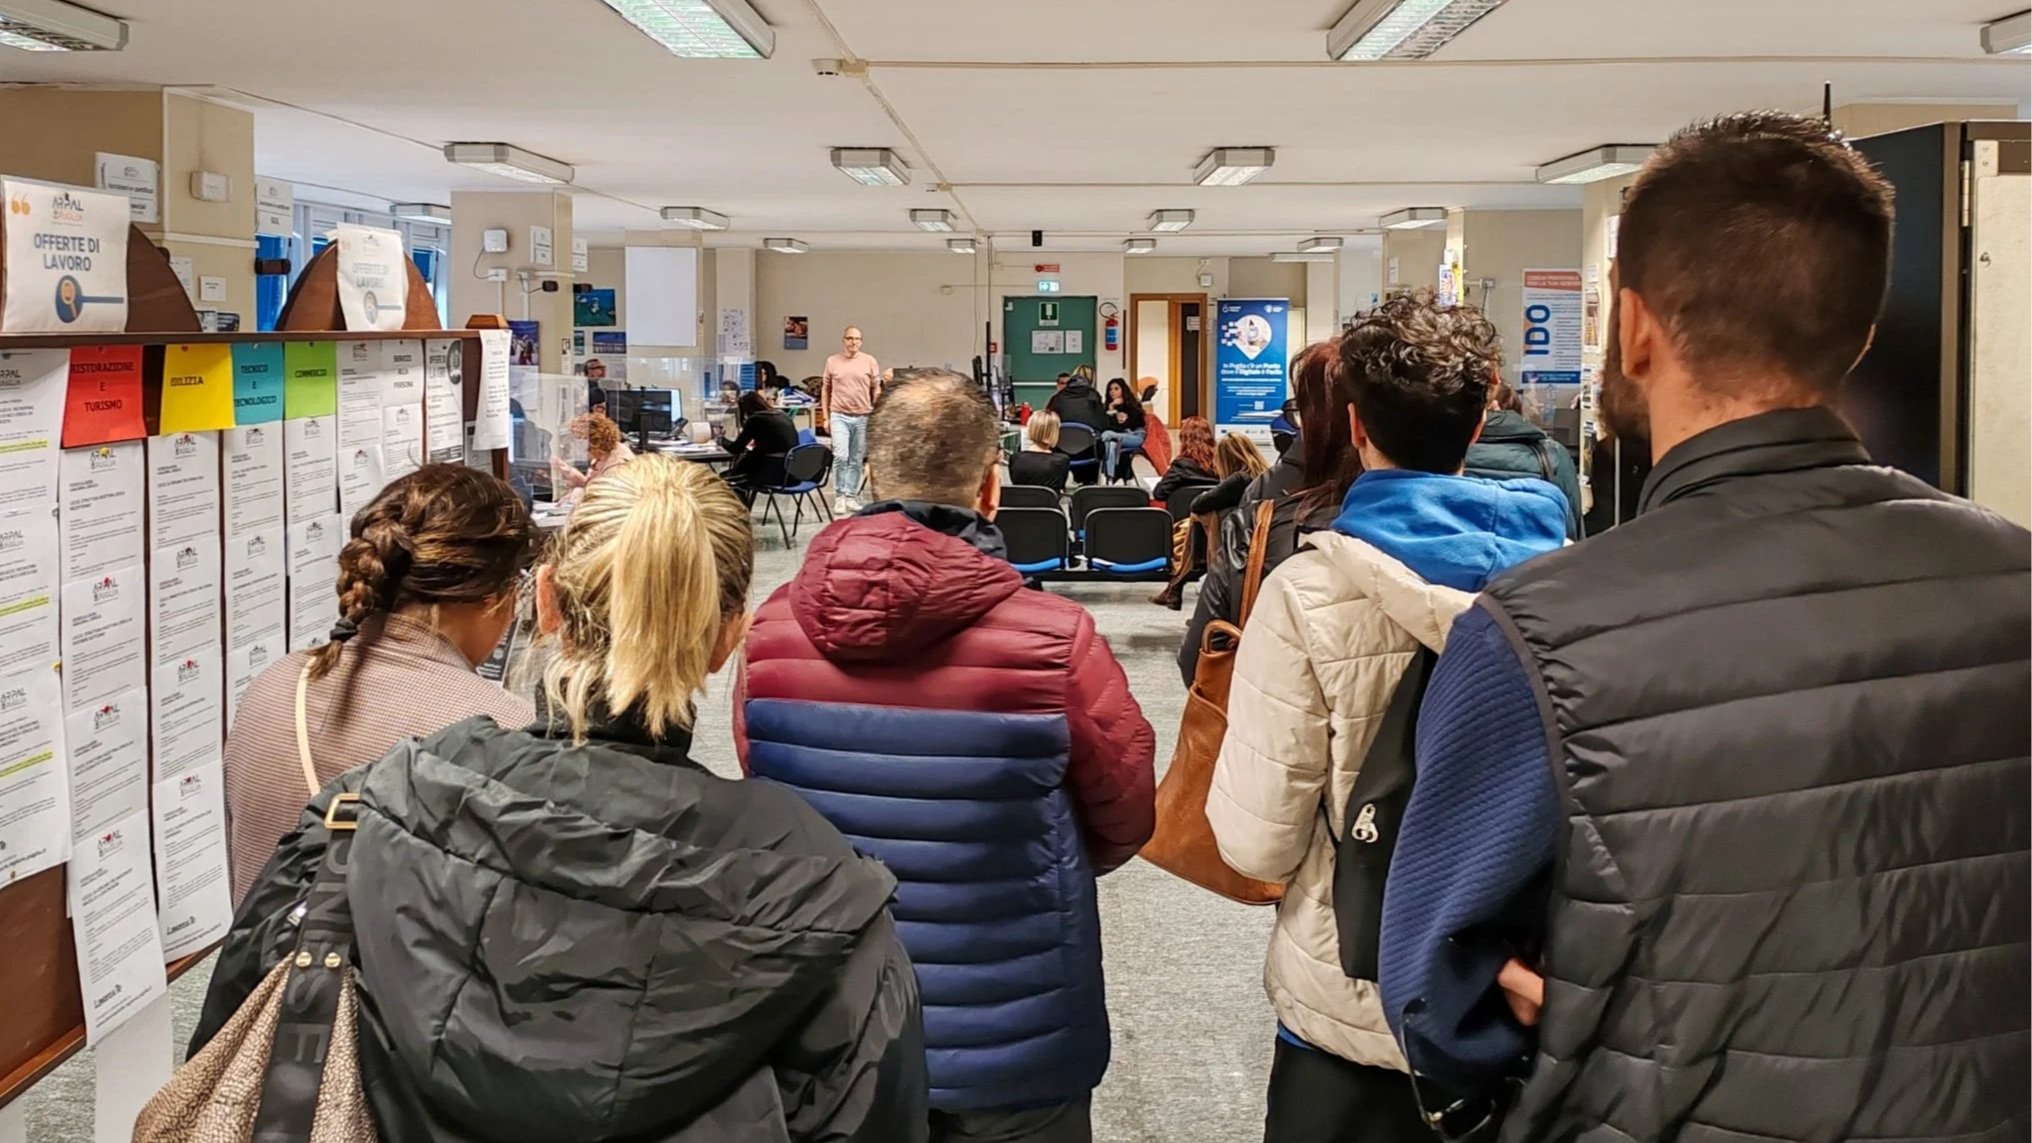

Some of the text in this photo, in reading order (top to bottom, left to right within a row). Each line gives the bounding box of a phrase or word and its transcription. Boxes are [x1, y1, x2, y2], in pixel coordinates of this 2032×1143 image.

[34, 233, 100, 253] OFFERTE DI
[43, 254, 91, 271] LAVORO
[1525, 305, 1550, 355] IDO
[70, 361, 134, 374] RISTORAZIONE
[100, 382, 106, 391] E
[252, 381, 257, 390] E
[84, 399, 123, 412] TURISMO
